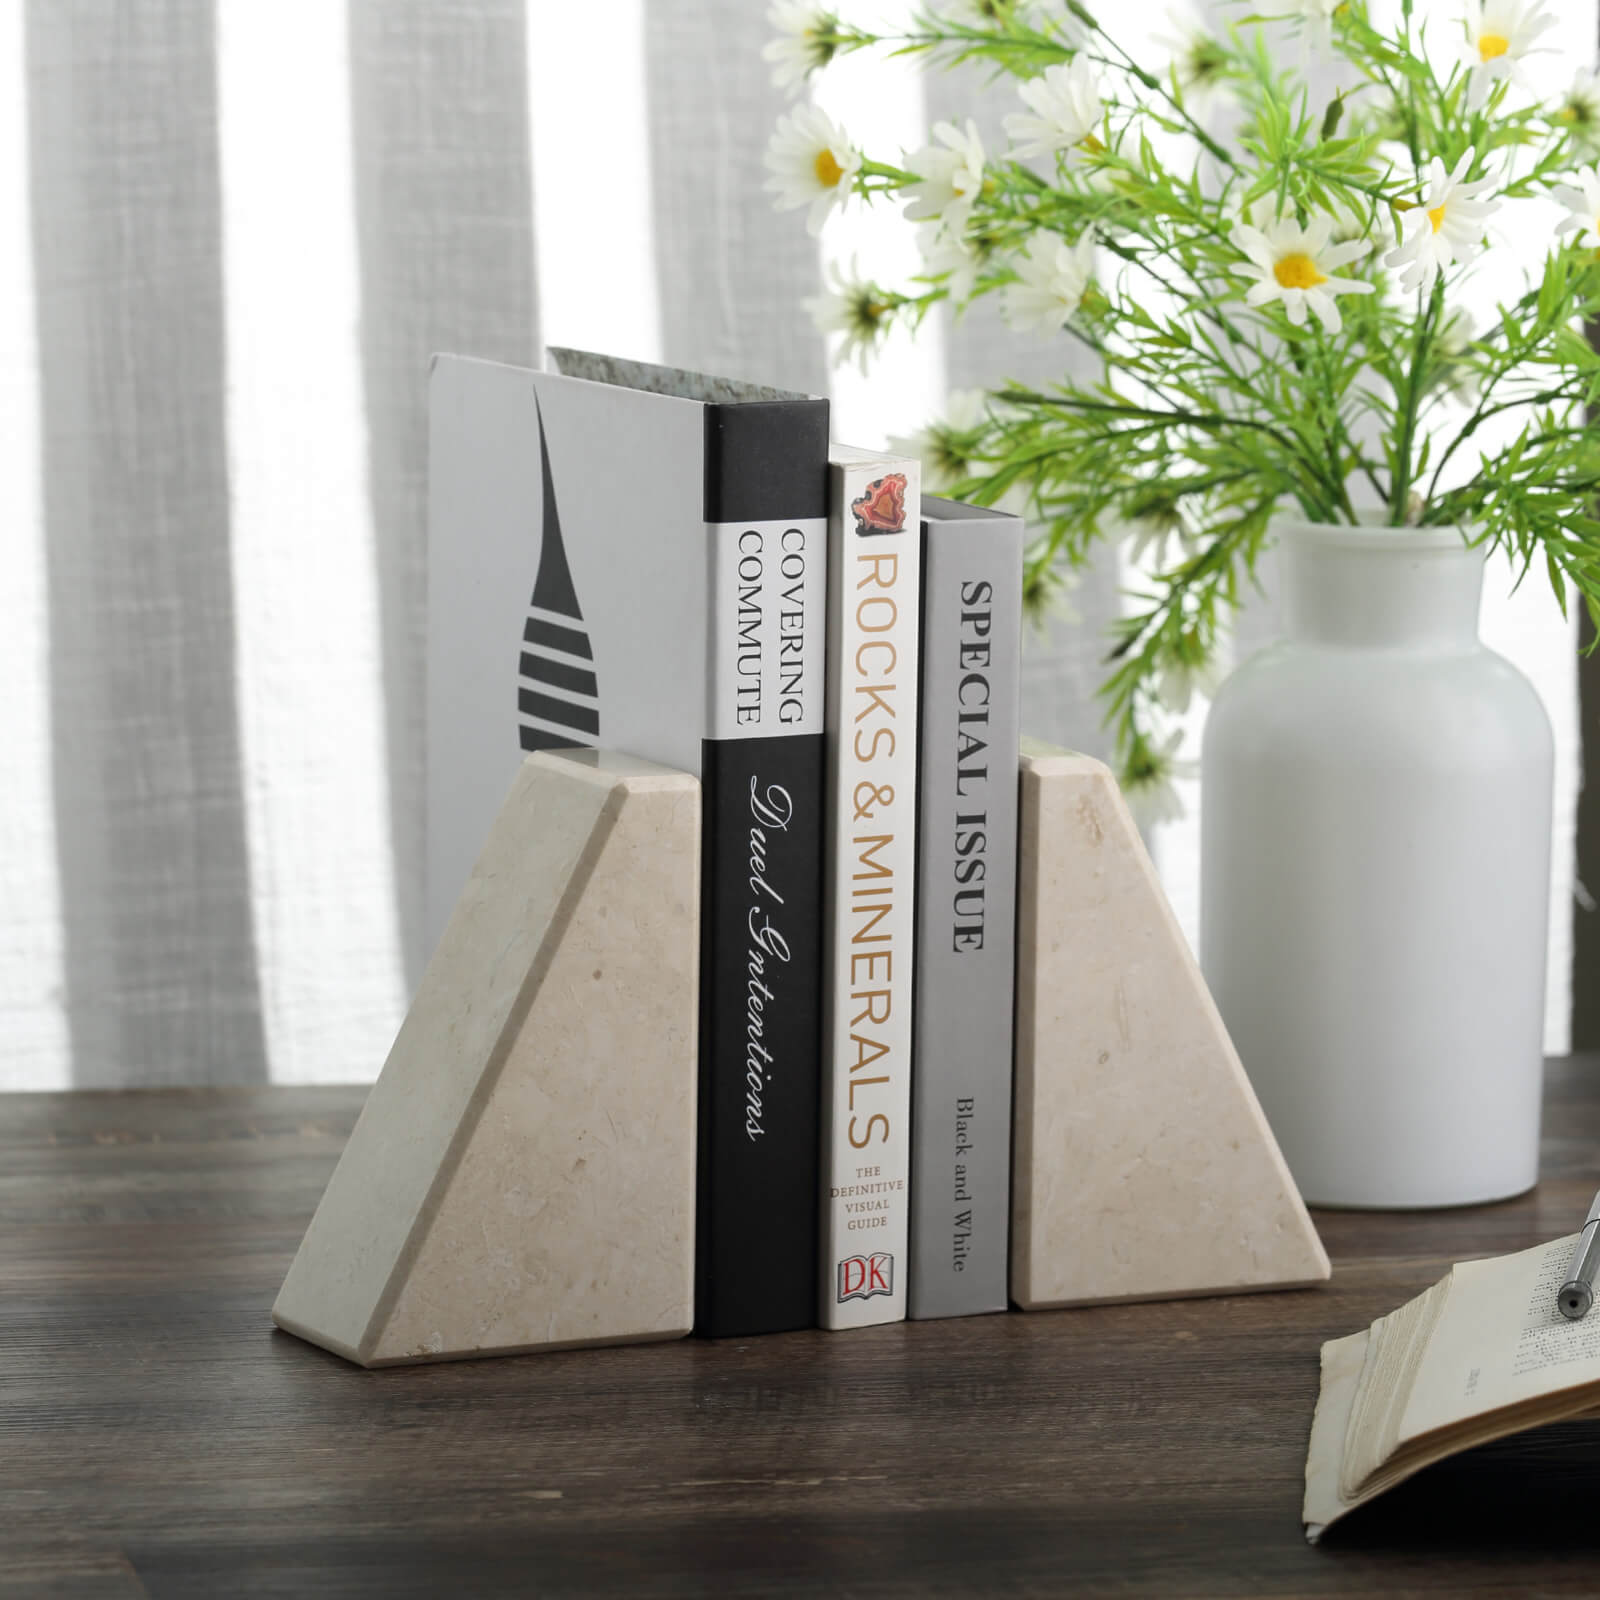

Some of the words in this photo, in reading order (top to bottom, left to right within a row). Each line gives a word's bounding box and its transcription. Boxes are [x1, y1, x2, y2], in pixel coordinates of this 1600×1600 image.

[736, 530, 764, 726] COMMUTE
[778, 528, 806, 724] COVERING
[853, 553, 898, 762] ROCKS
[955, 580, 993, 796] SPECIAL
[853, 780, 895, 822] &
[749, 775, 793, 904] Duel
[952, 811, 987, 953] ISSUE
[848, 834, 895, 1149] MINERALS
[745, 905, 791, 1142] Intentions
[955, 1097, 974, 1156] Black
[830, 1180, 904, 1198] DEFINITIVE
[855, 1166, 881, 1179] THE
[954, 1164, 972, 1201] and
[845, 1200, 890, 1214] VISUAL
[847, 1216, 888, 1231] GUIDE
[952, 1209, 973, 1272] White
[842, 1256, 889, 1295] DK
